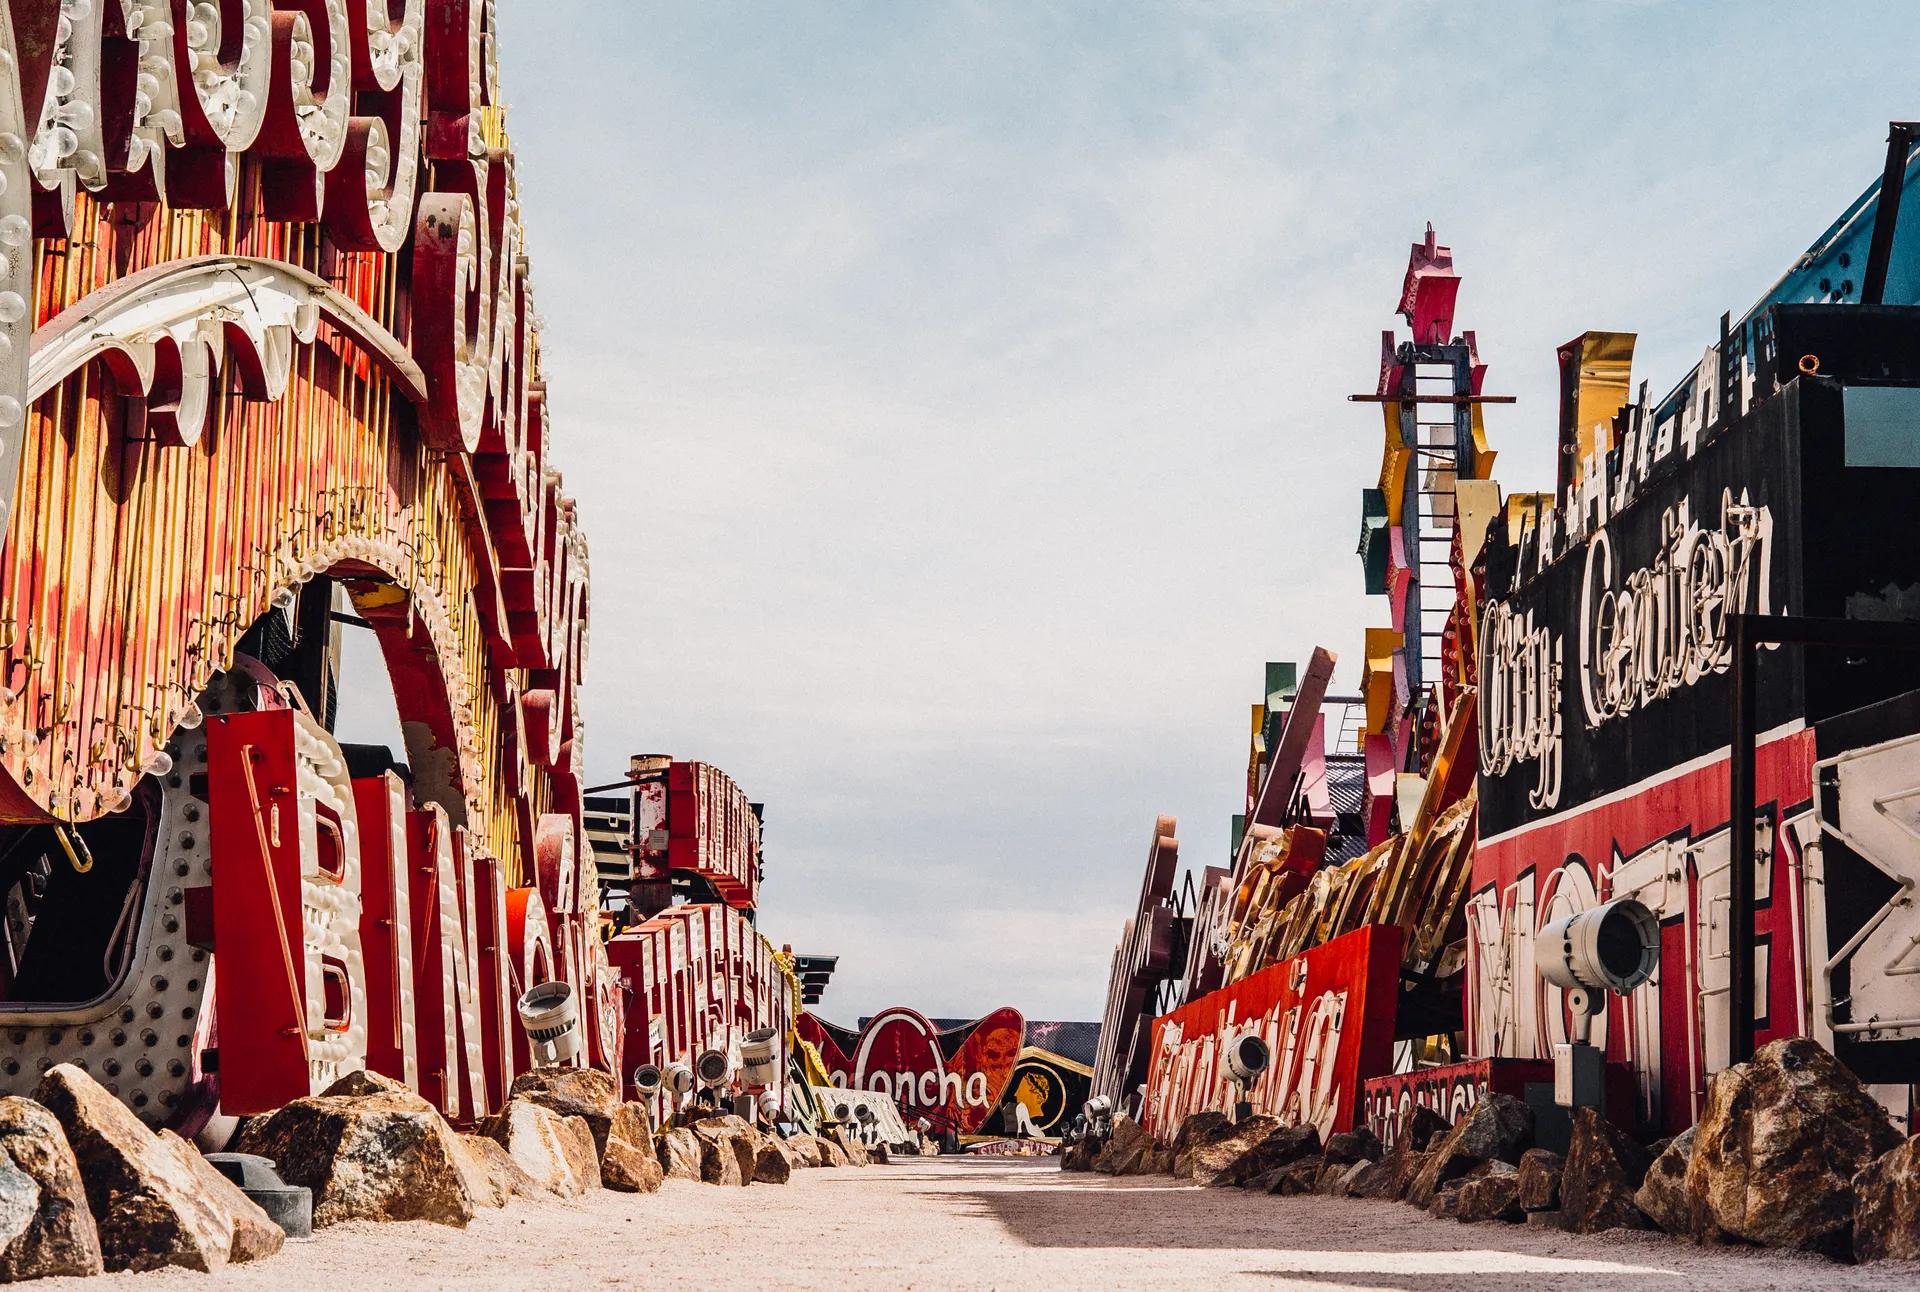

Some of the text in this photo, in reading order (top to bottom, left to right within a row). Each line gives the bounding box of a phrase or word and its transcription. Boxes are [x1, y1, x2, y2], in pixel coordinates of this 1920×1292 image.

[1477, 486, 1790, 811] City Center
[854, 1013, 990, 1109] Concha
[1466, 808, 1840, 1136] MOTEL
